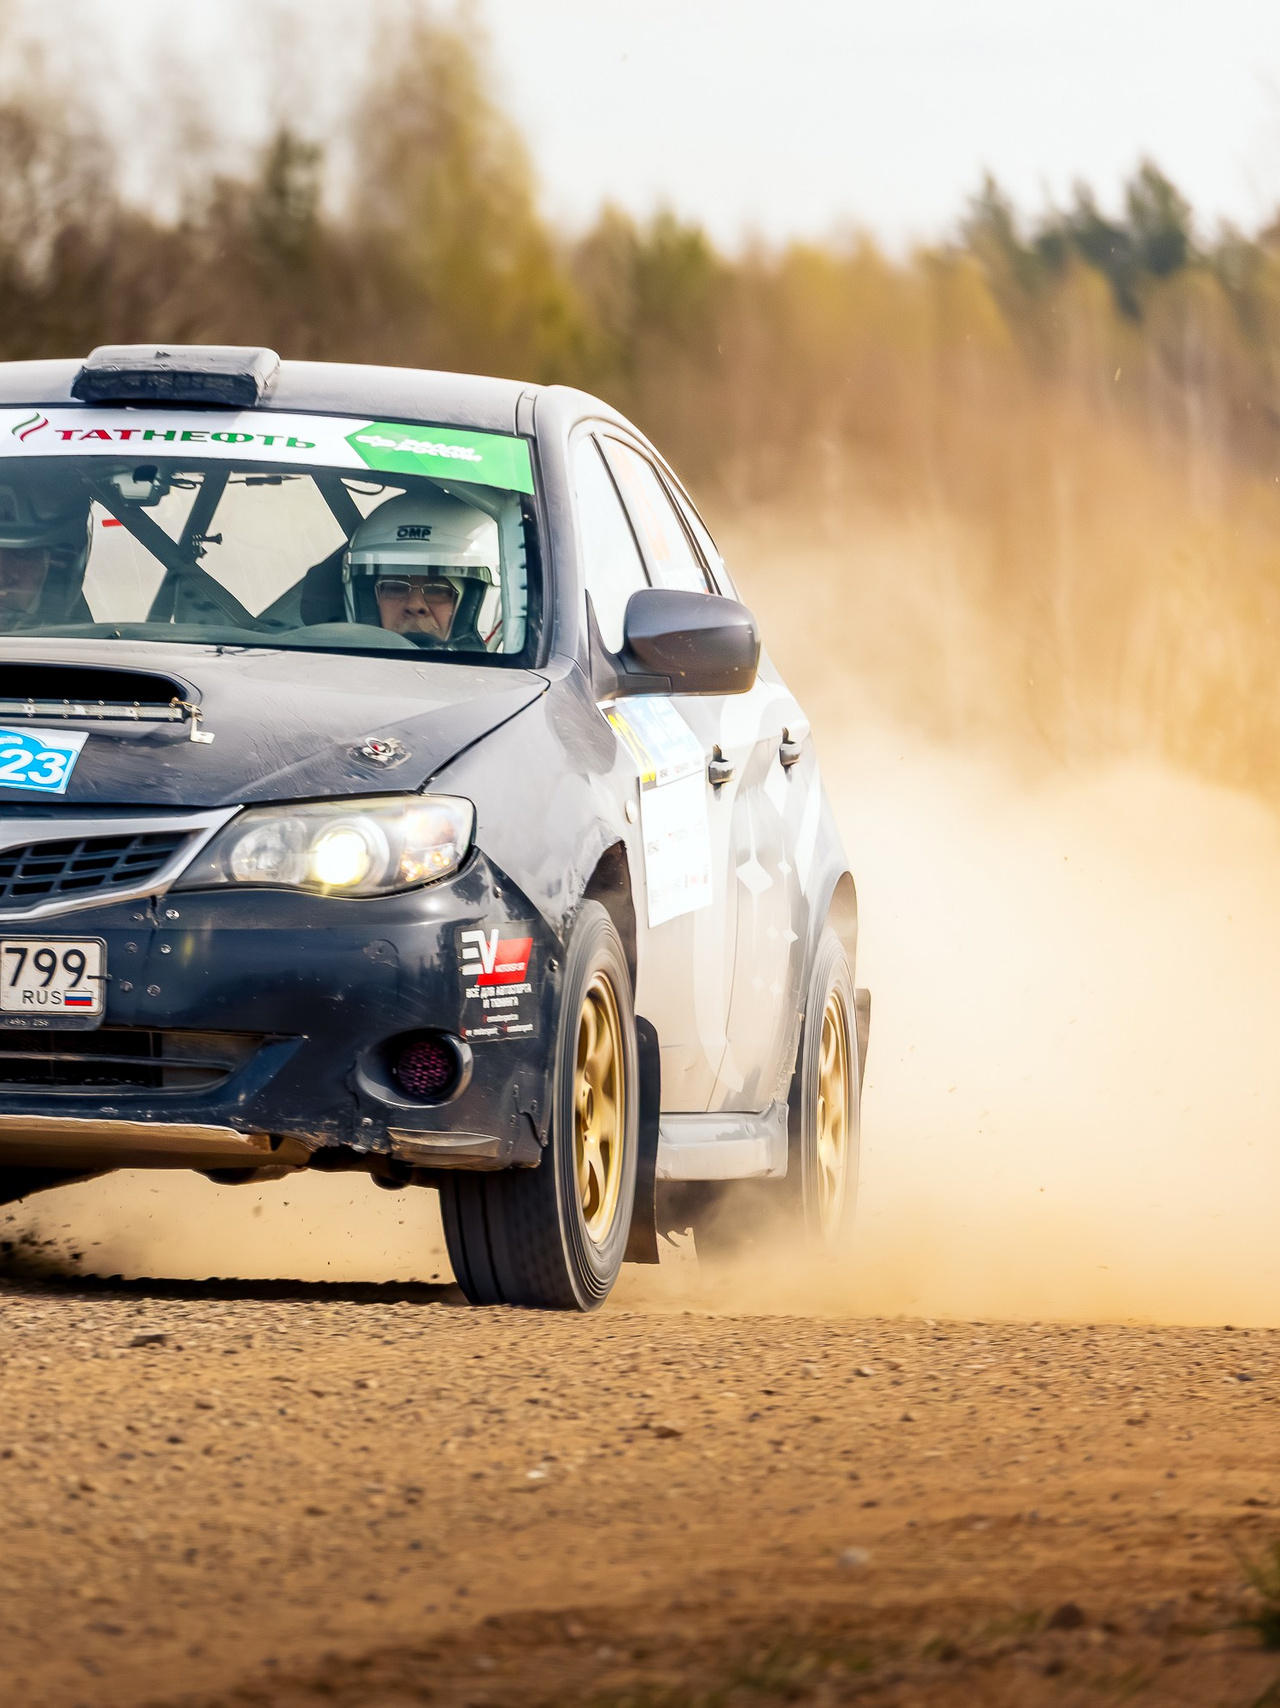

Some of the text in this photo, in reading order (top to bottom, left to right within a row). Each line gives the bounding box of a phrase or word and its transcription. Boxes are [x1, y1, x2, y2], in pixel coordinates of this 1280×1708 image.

[54, 429, 317, 449] ТАТНЕФТЬ
[396, 526, 431, 539] OMP
[461, 928, 500, 975] EV
[5, 947, 88, 987] 799
[22, 989, 63, 1005] RUS
